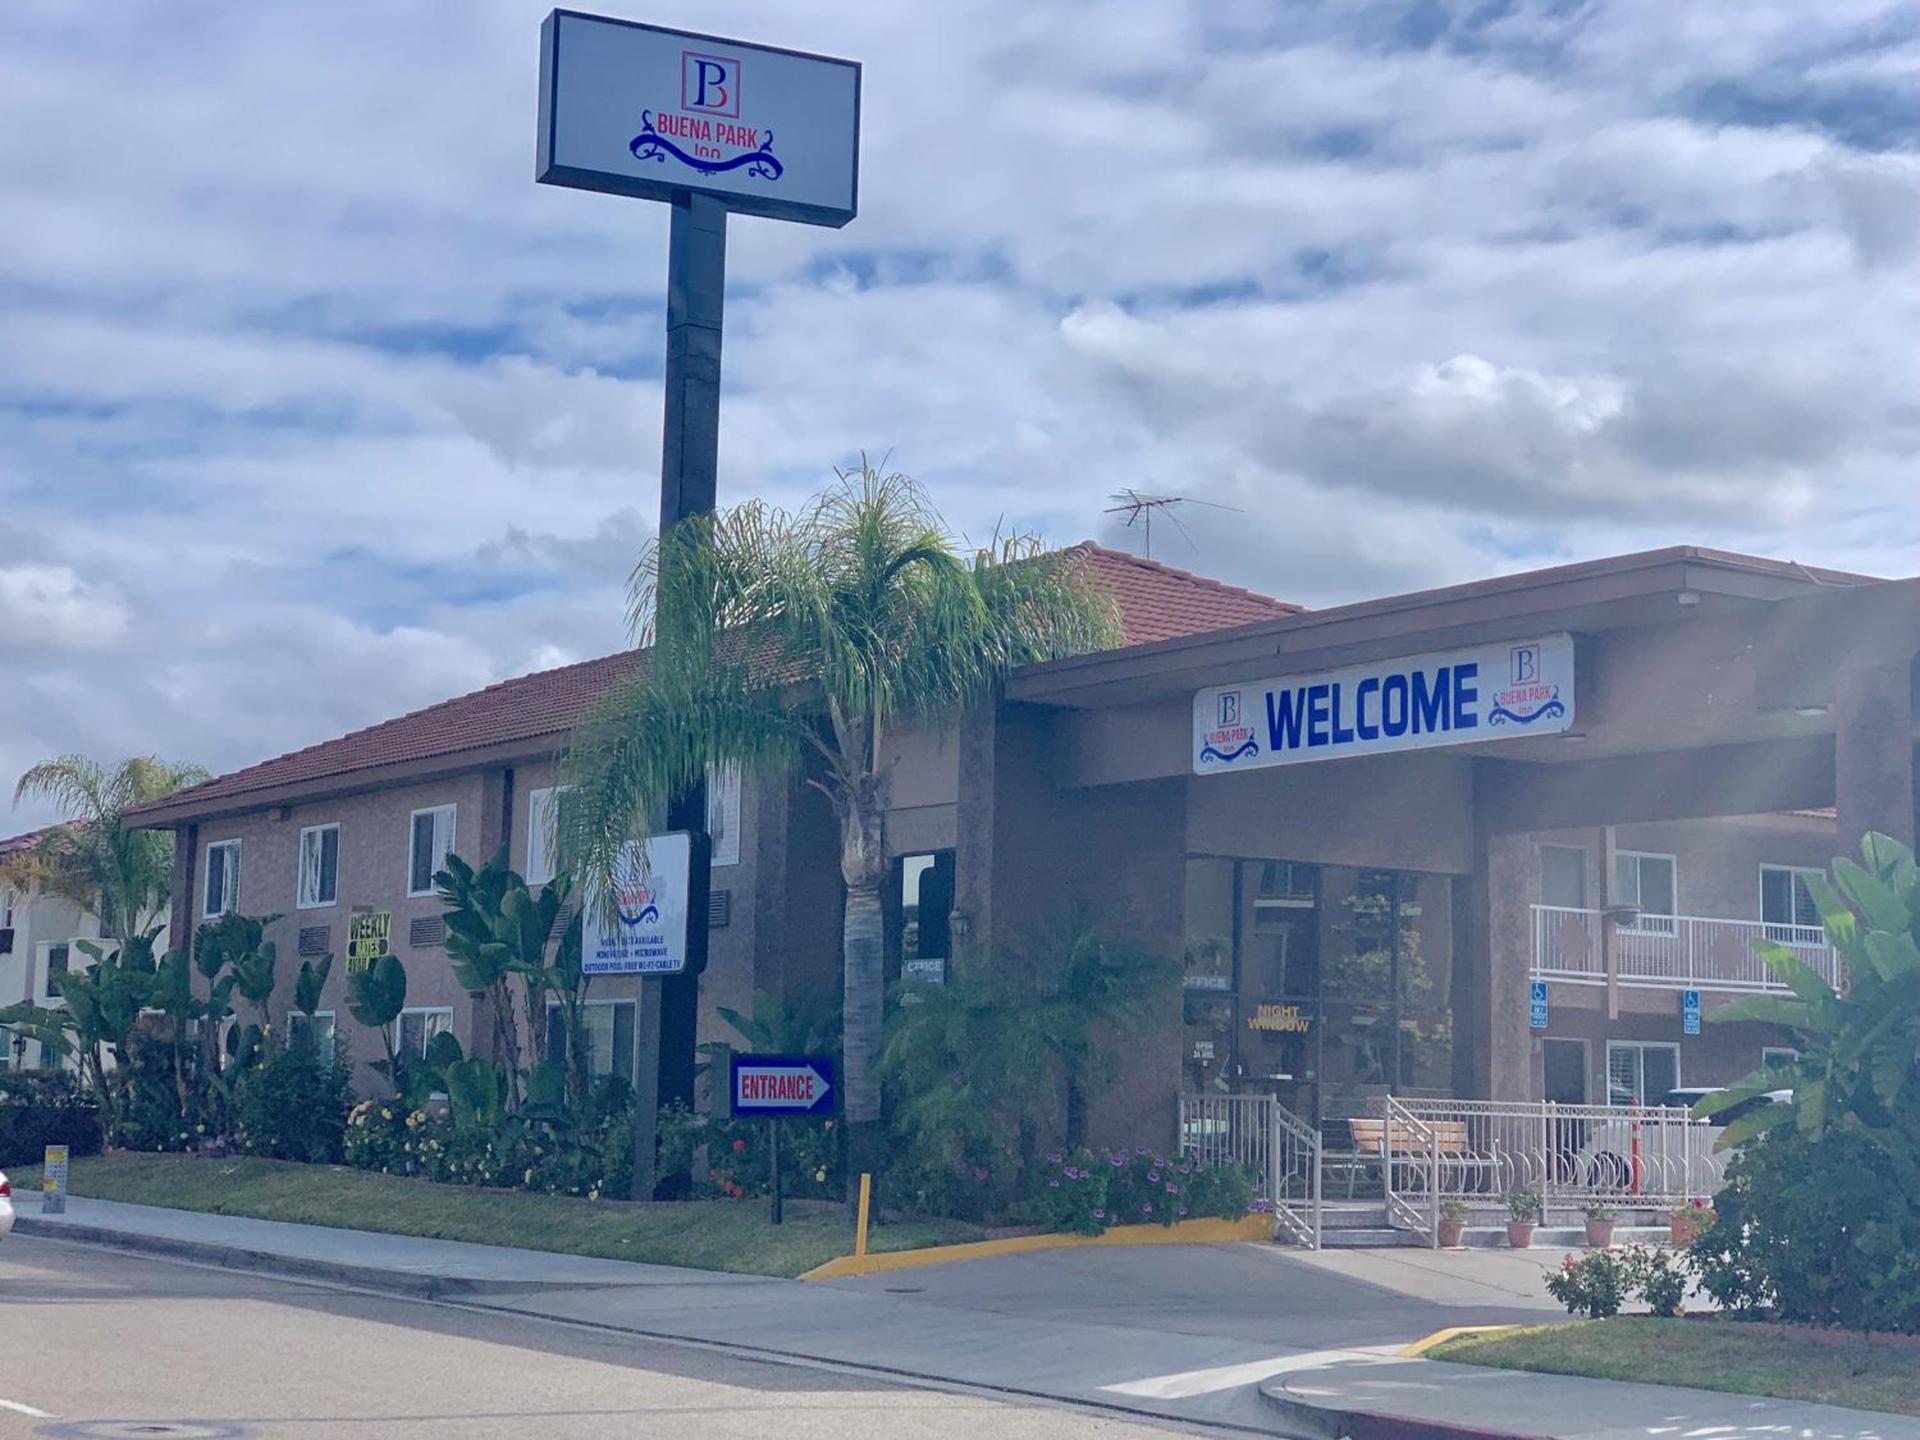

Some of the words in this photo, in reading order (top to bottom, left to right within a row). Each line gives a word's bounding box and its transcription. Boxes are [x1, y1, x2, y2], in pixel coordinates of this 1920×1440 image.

[657, 113, 711, 141] BUENA
[716, 123, 757, 149] PARK
[1500, 689, 1527, 705] BUENA
[1529, 685, 1552, 701] PARK
[1265, 663, 1478, 751] WELCOME
[1208, 730, 1231, 744] BUENA
[1232, 727, 1249, 742] PARK
[350, 913, 390, 940] WEEKLY
[635, 935, 664, 945] AVAILABLE
[634, 947, 668, 957] MICROWAVE
[1258, 1004, 1299, 1017] NIGHT
[1248, 1017, 1309, 1032] WINDOW
[741, 1074, 814, 1100] ENTRANCE
